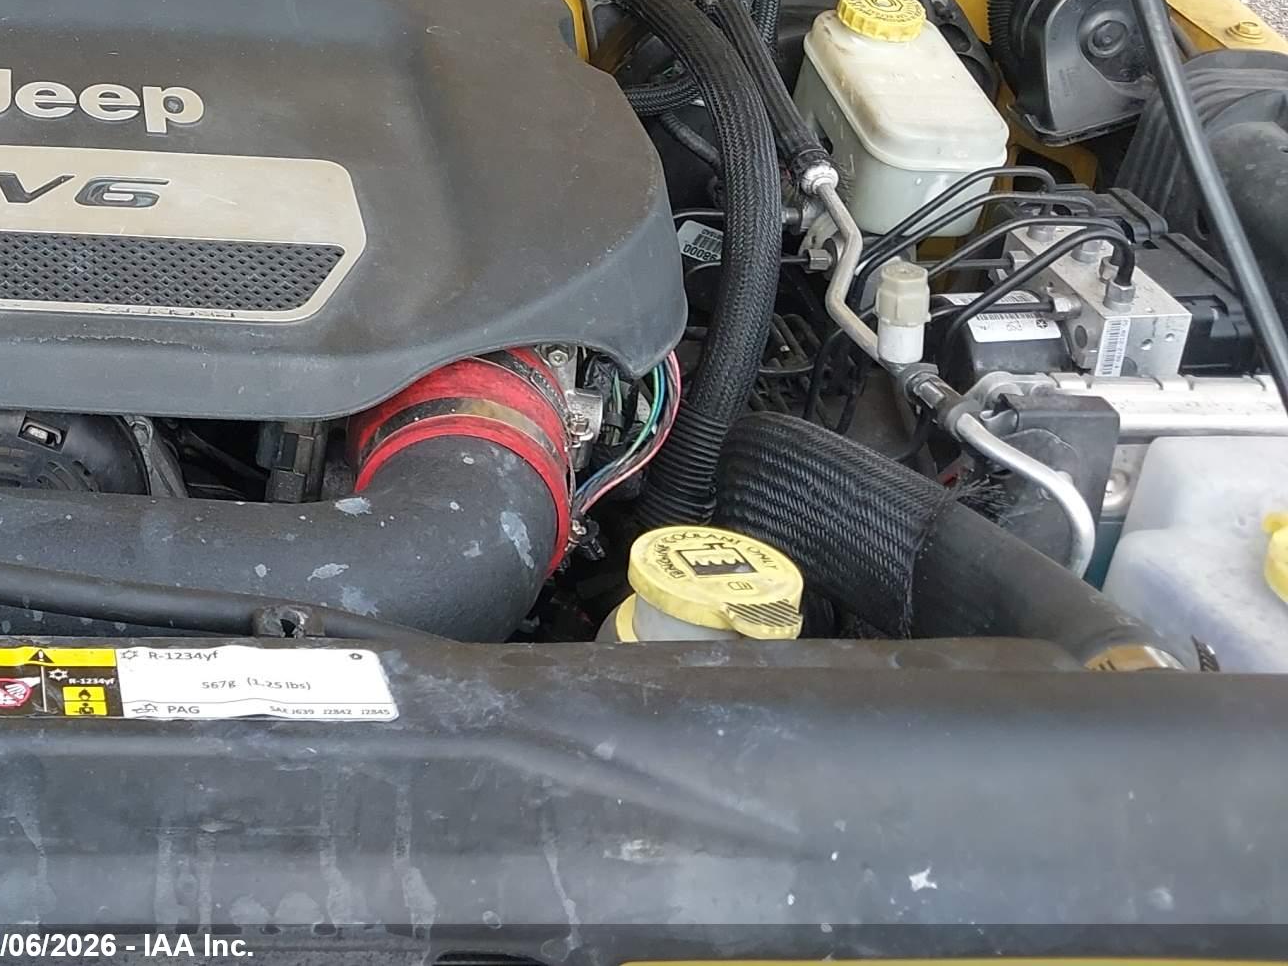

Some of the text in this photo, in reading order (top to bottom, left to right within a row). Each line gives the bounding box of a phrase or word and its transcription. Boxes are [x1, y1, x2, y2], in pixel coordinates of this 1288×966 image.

[148, 650, 219, 662] R-1234yf
[68, 677, 116, 687] R-1234yf
[285, 681, 311, 691] lbs)
[167, 705, 201, 715] PAG
